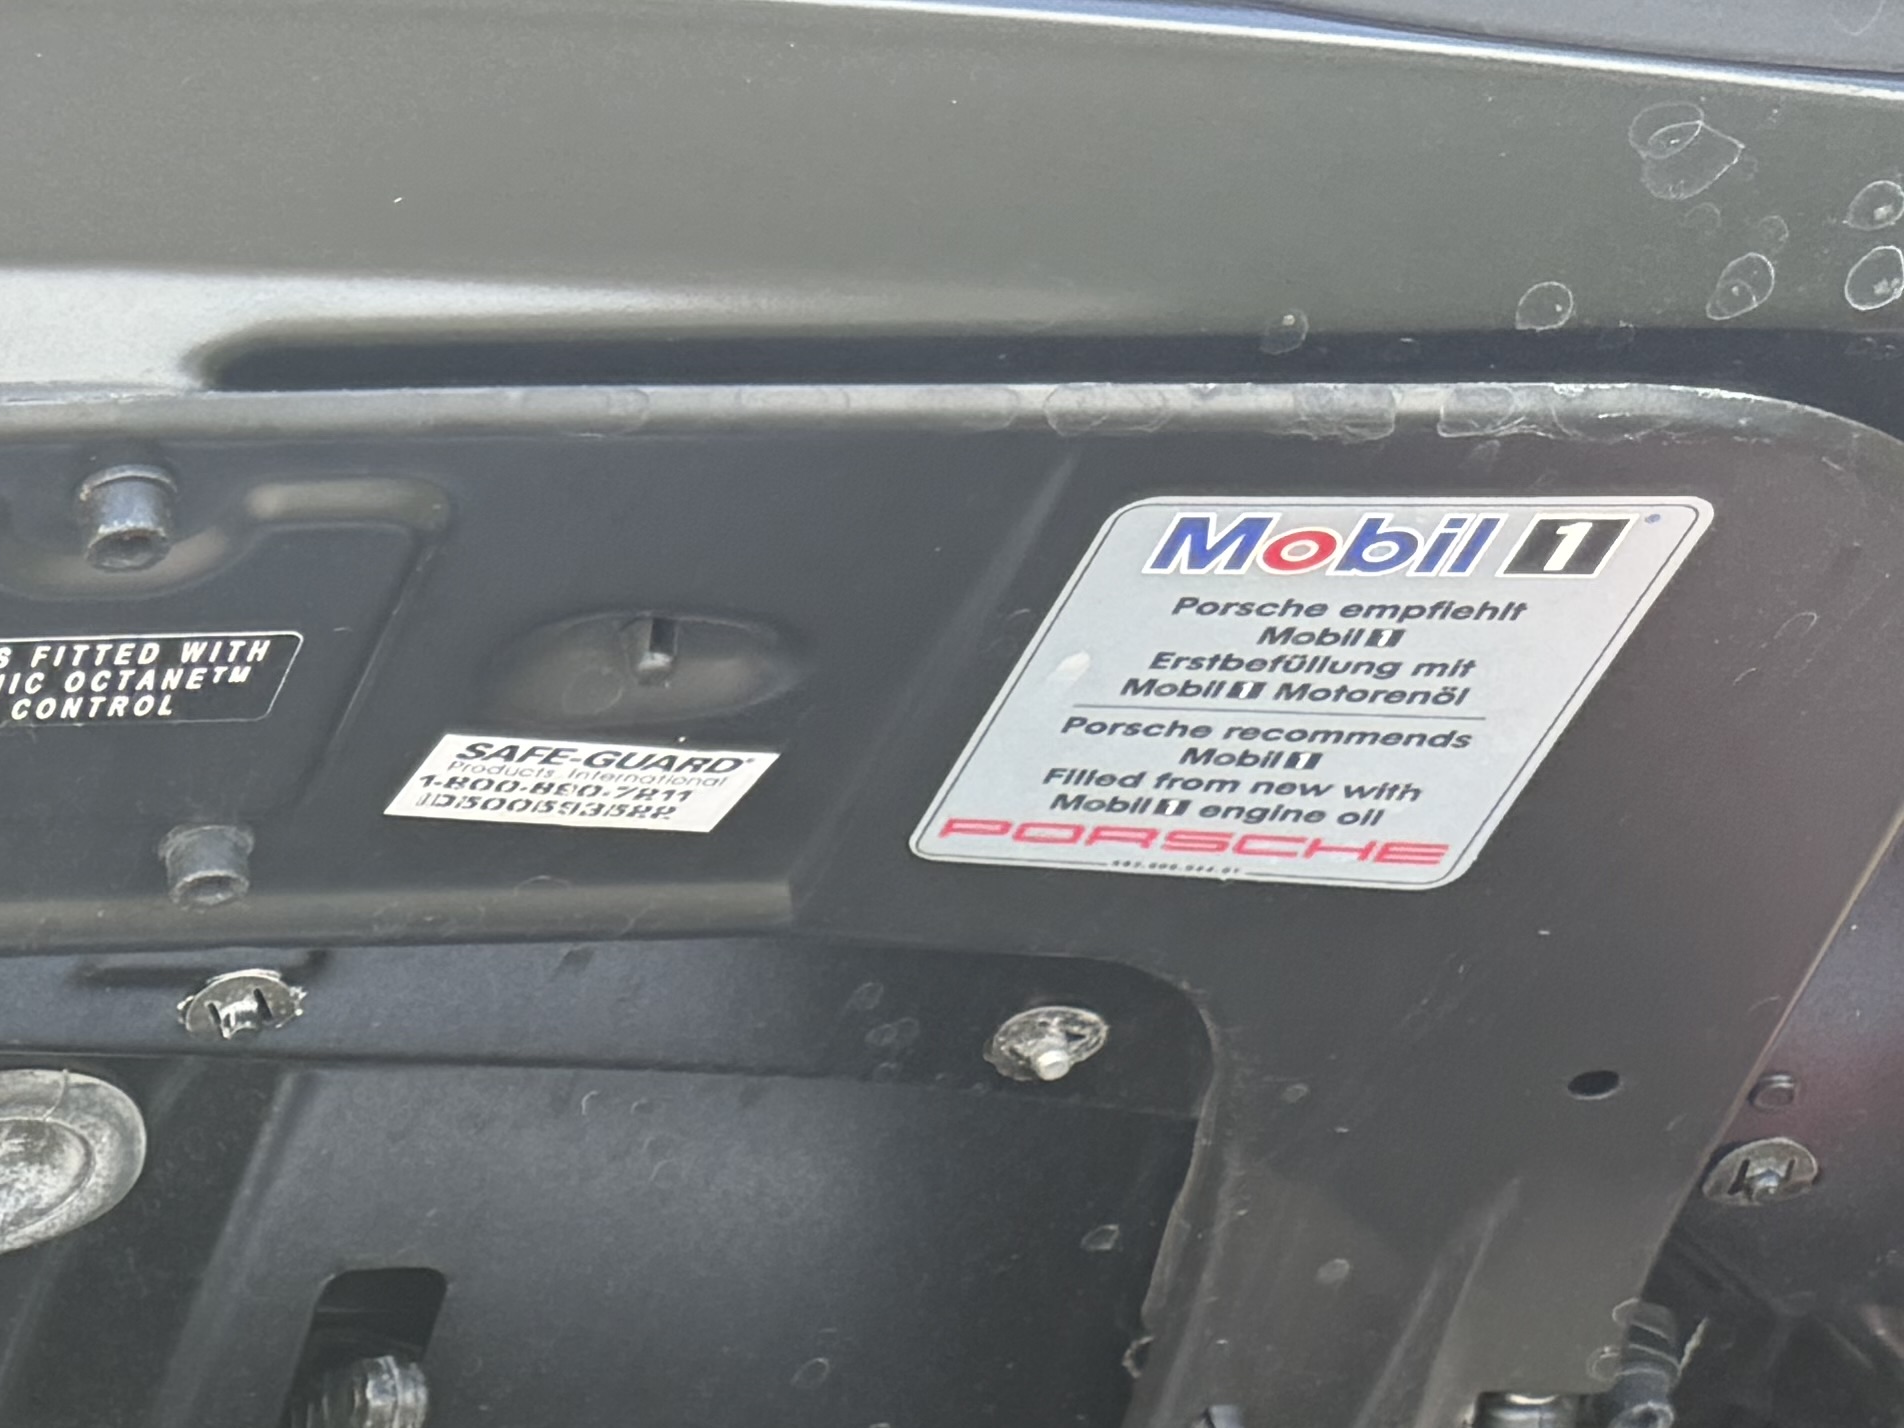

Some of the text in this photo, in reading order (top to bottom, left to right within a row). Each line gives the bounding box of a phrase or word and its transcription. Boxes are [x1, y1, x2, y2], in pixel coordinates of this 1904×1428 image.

[1145, 513, 1505, 576] Mobil
[1171, 597, 1527, 625] Porsche empfiehlt
[1258, 626, 1364, 649] Mobil
[30, 643, 159, 667] FITTED
[180, 640, 271, 664] WITH
[1151, 651, 1477, 680] Erstbefüllung mit
[1121, 677, 1470, 707] Mobil Motorenöl
[11, 696, 175, 721] CONTROL
[1060, 715, 1474, 751] Porsche recommends
[1180, 747, 1284, 768] Mobil
[568, 768, 728, 787] International
[1043, 768, 1423, 805] Filled from new with
[1051, 793, 1386, 827] Mobil engine oil
[939, 816, 1452, 867] PORSCHE
